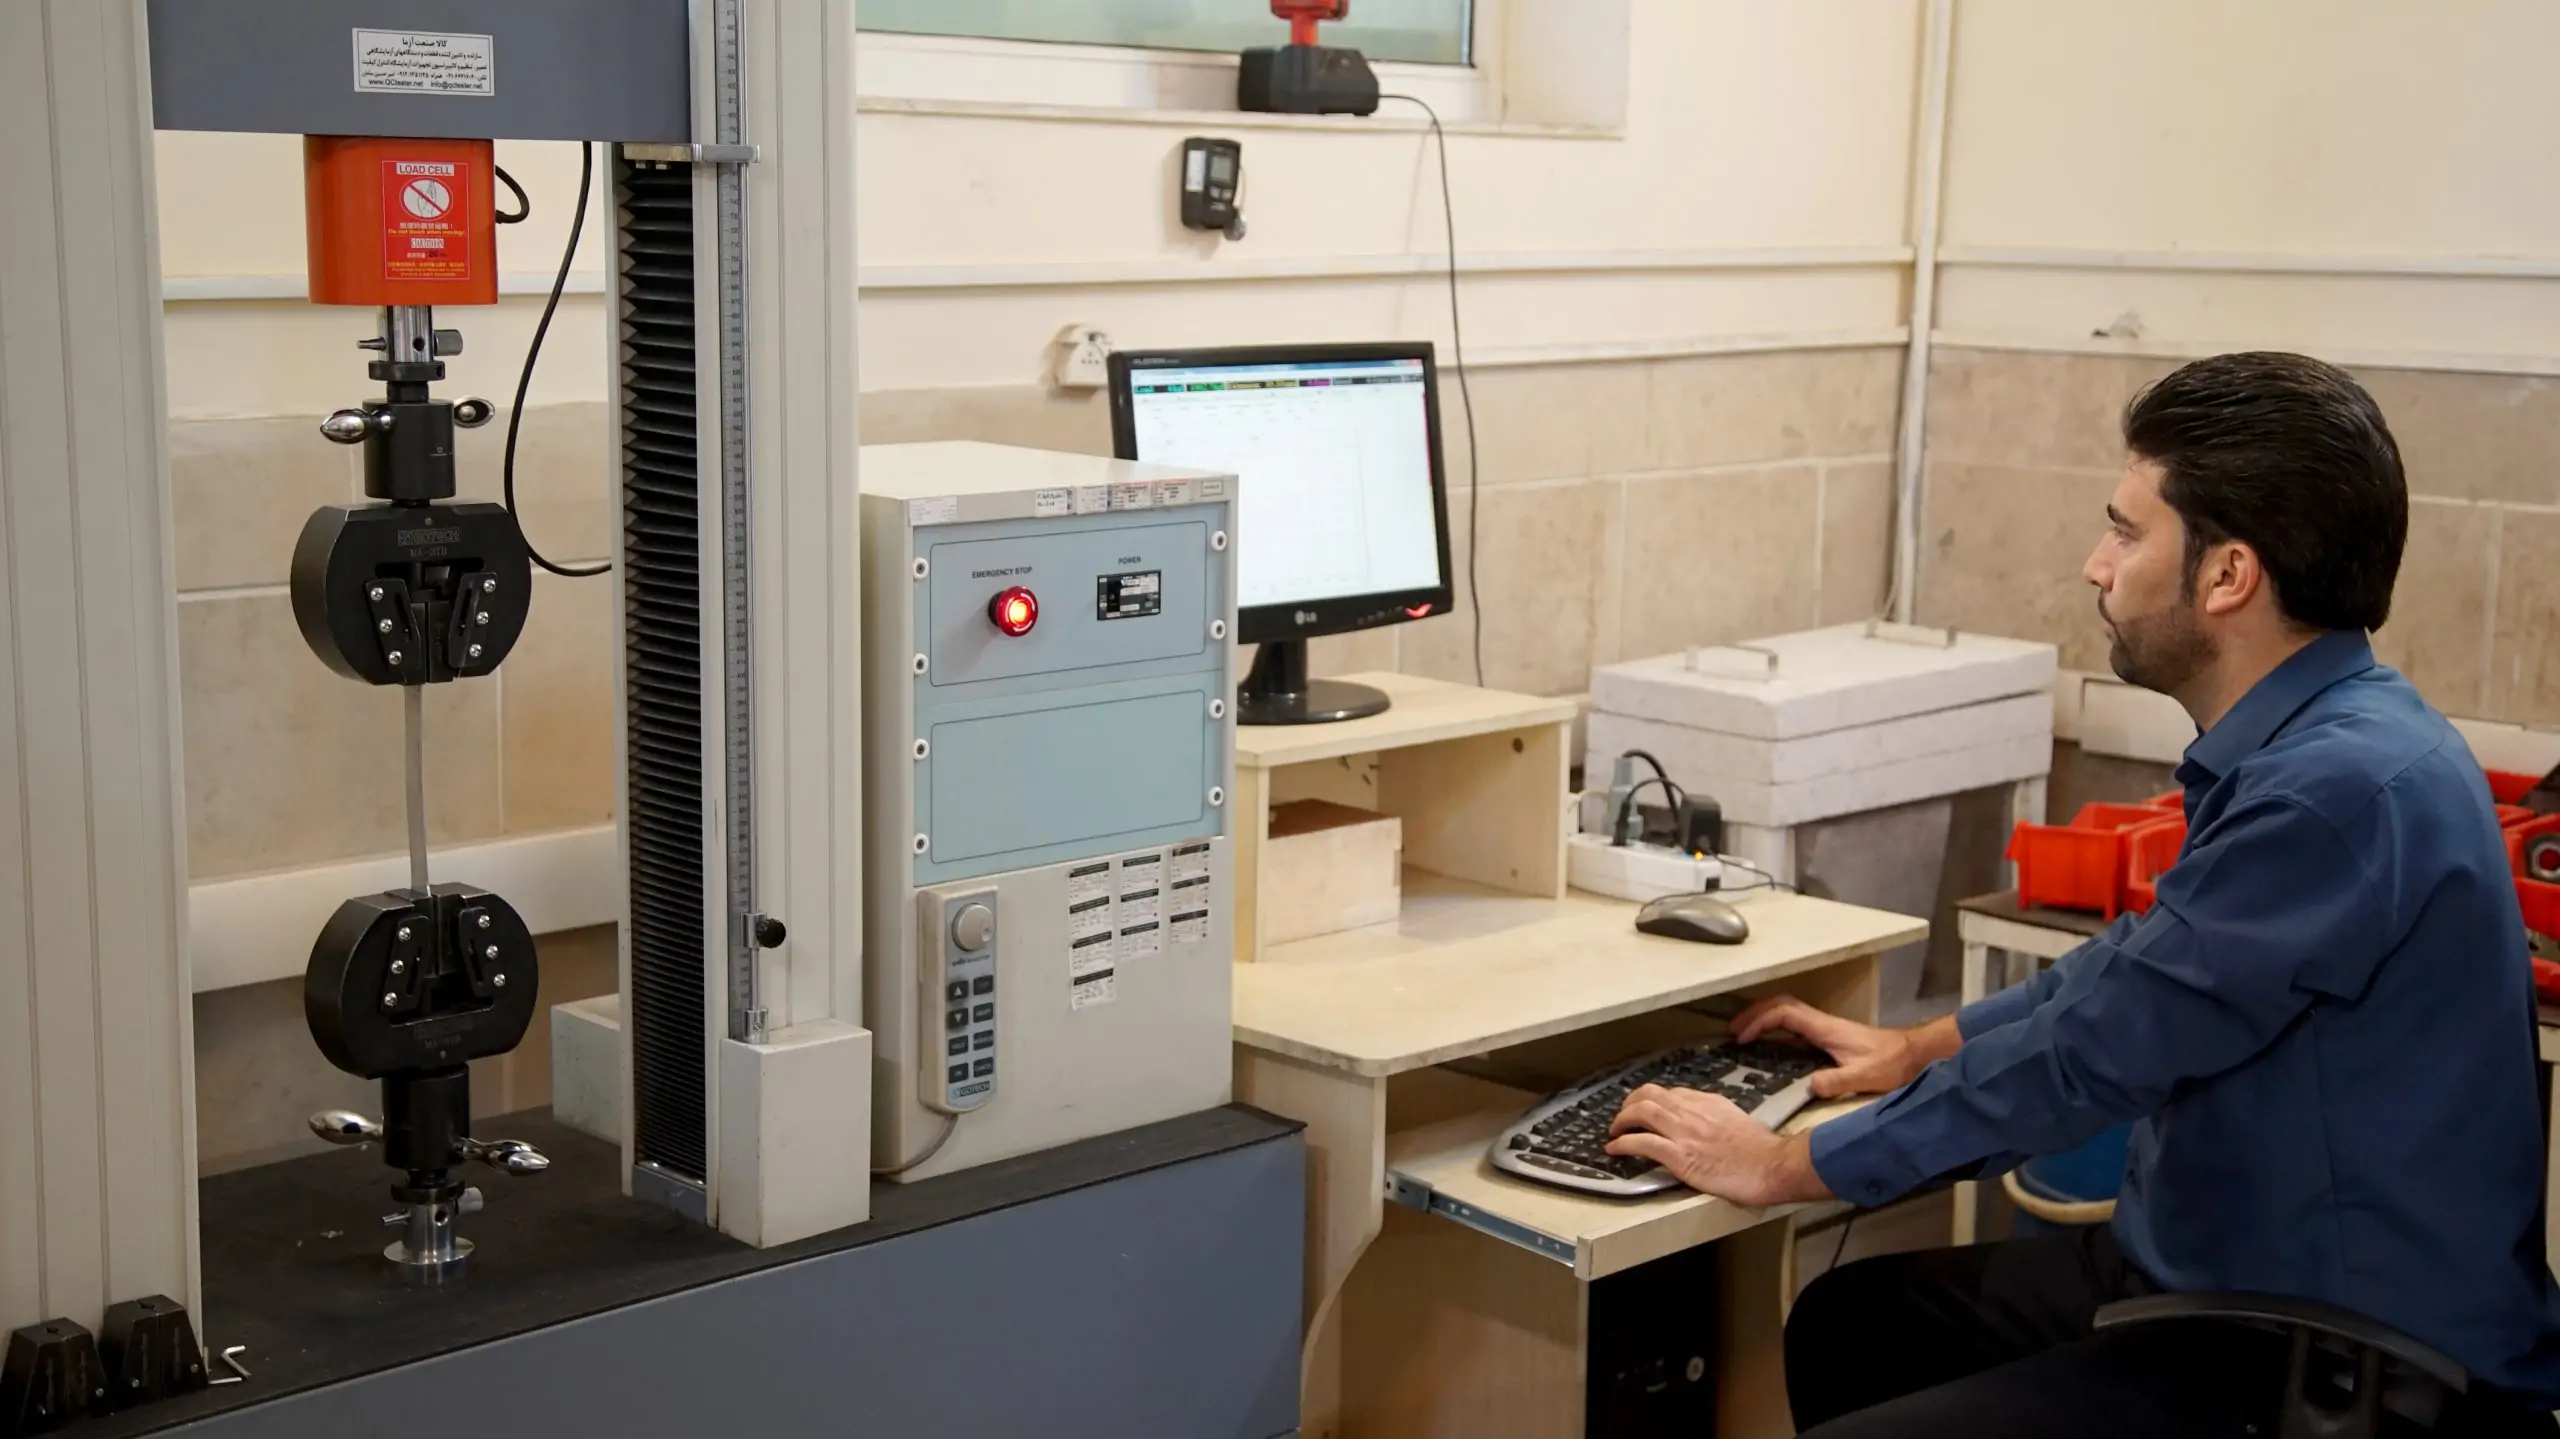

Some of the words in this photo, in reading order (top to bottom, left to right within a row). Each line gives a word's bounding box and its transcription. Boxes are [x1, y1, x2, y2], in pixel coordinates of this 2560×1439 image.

[400, 165, 426, 174] LOAD
[428, 166, 452, 175] CELL
[1118, 556, 1142, 565] POWER
[972, 568, 1013, 579] EMERGENCY
[1014, 566, 1032, 575] STOP
